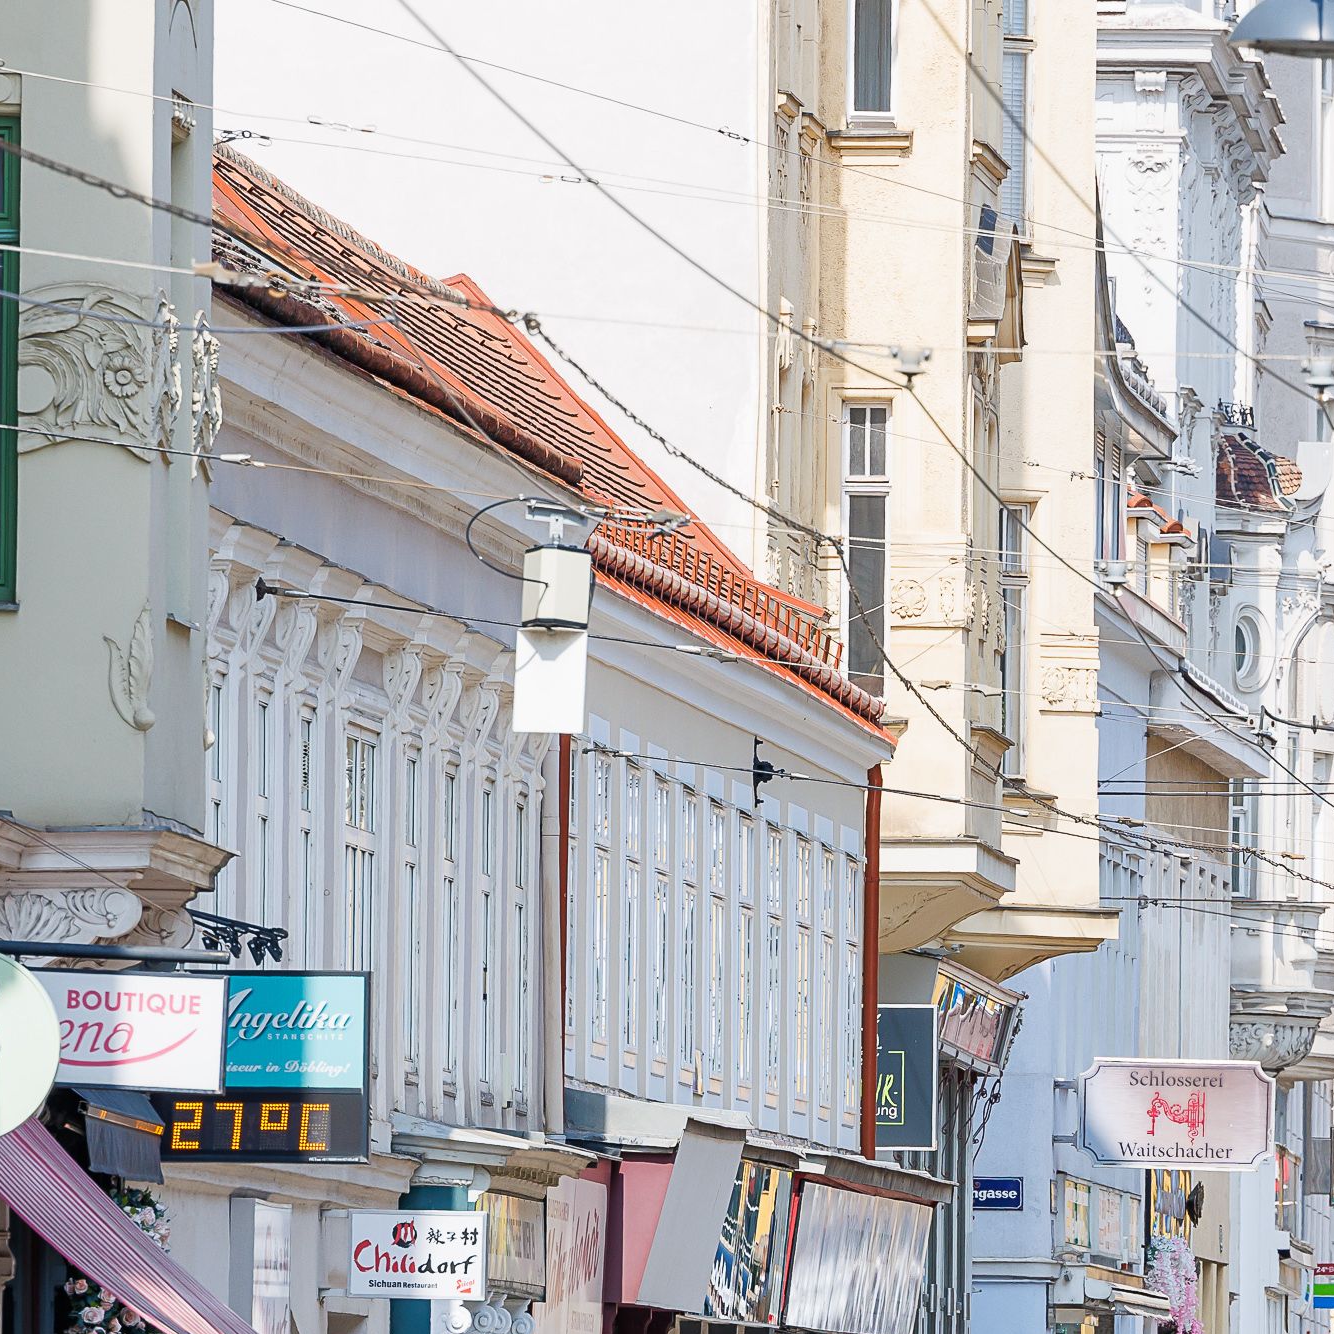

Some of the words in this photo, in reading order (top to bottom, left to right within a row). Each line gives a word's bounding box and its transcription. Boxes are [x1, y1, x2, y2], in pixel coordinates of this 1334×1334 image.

[67, 989, 200, 1015] BOUTIQUE
[59, 1019, 134, 1054] ena
[226, 1061, 262, 1073] iseur
[266, 1061, 280, 1073] in
[1129, 1070, 1224, 1088] Schlosserei
[1118, 1142, 1233, 1159] Waitschacher
[972, 1189, 1018, 1202] ngasse
[353, 1239, 478, 1275] Chilidorf
[368, 1280, 402, 1288] Sichuan
